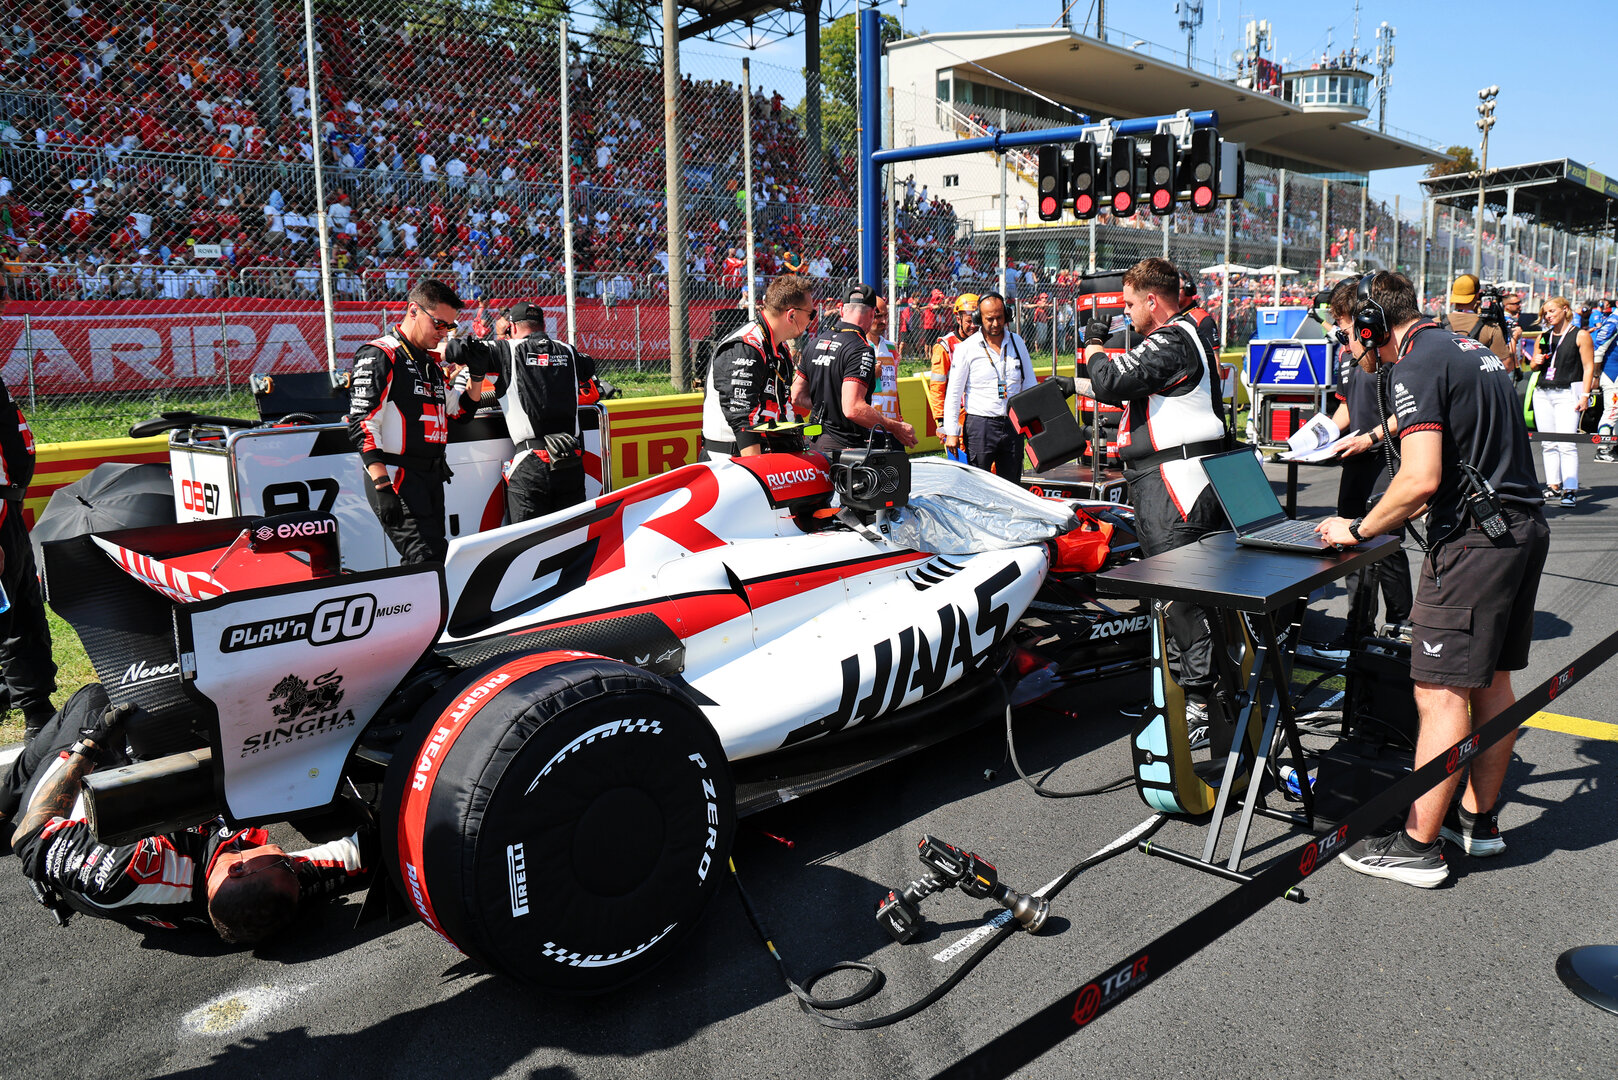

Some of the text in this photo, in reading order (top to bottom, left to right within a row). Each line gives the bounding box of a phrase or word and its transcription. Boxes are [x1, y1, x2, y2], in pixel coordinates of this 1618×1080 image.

[581, 333, 616, 350] Visit
[649, 338, 671, 351] we
[734, 387, 747, 396] FIX
[766, 468, 816, 487] RUCKUS
[277, 518, 336, 539] exein
[311, 597, 376, 643] GO
[376, 603, 412, 618] MUSIC
[1089, 615, 1152, 640] ZOOMEX
[121, 660, 180, 685] Never
[778, 561, 1021, 749] HAAS
[1559, 667, 1575, 684] TGR
[240, 722, 356, 759] CORPORATION
[241, 708, 356, 752] SINGHA
[411, 673, 512, 792] RIGHT REAR
[1459, 734, 1480, 756] TGR
[688, 752, 719, 882] P ZERO
[1319, 824, 1349, 853] TGR
[95, 848, 116, 891] HAAS
[507, 842, 529, 917] PIRELLI
[405, 861, 437, 929] RIGHT
[1102, 955, 1149, 996] TGR
